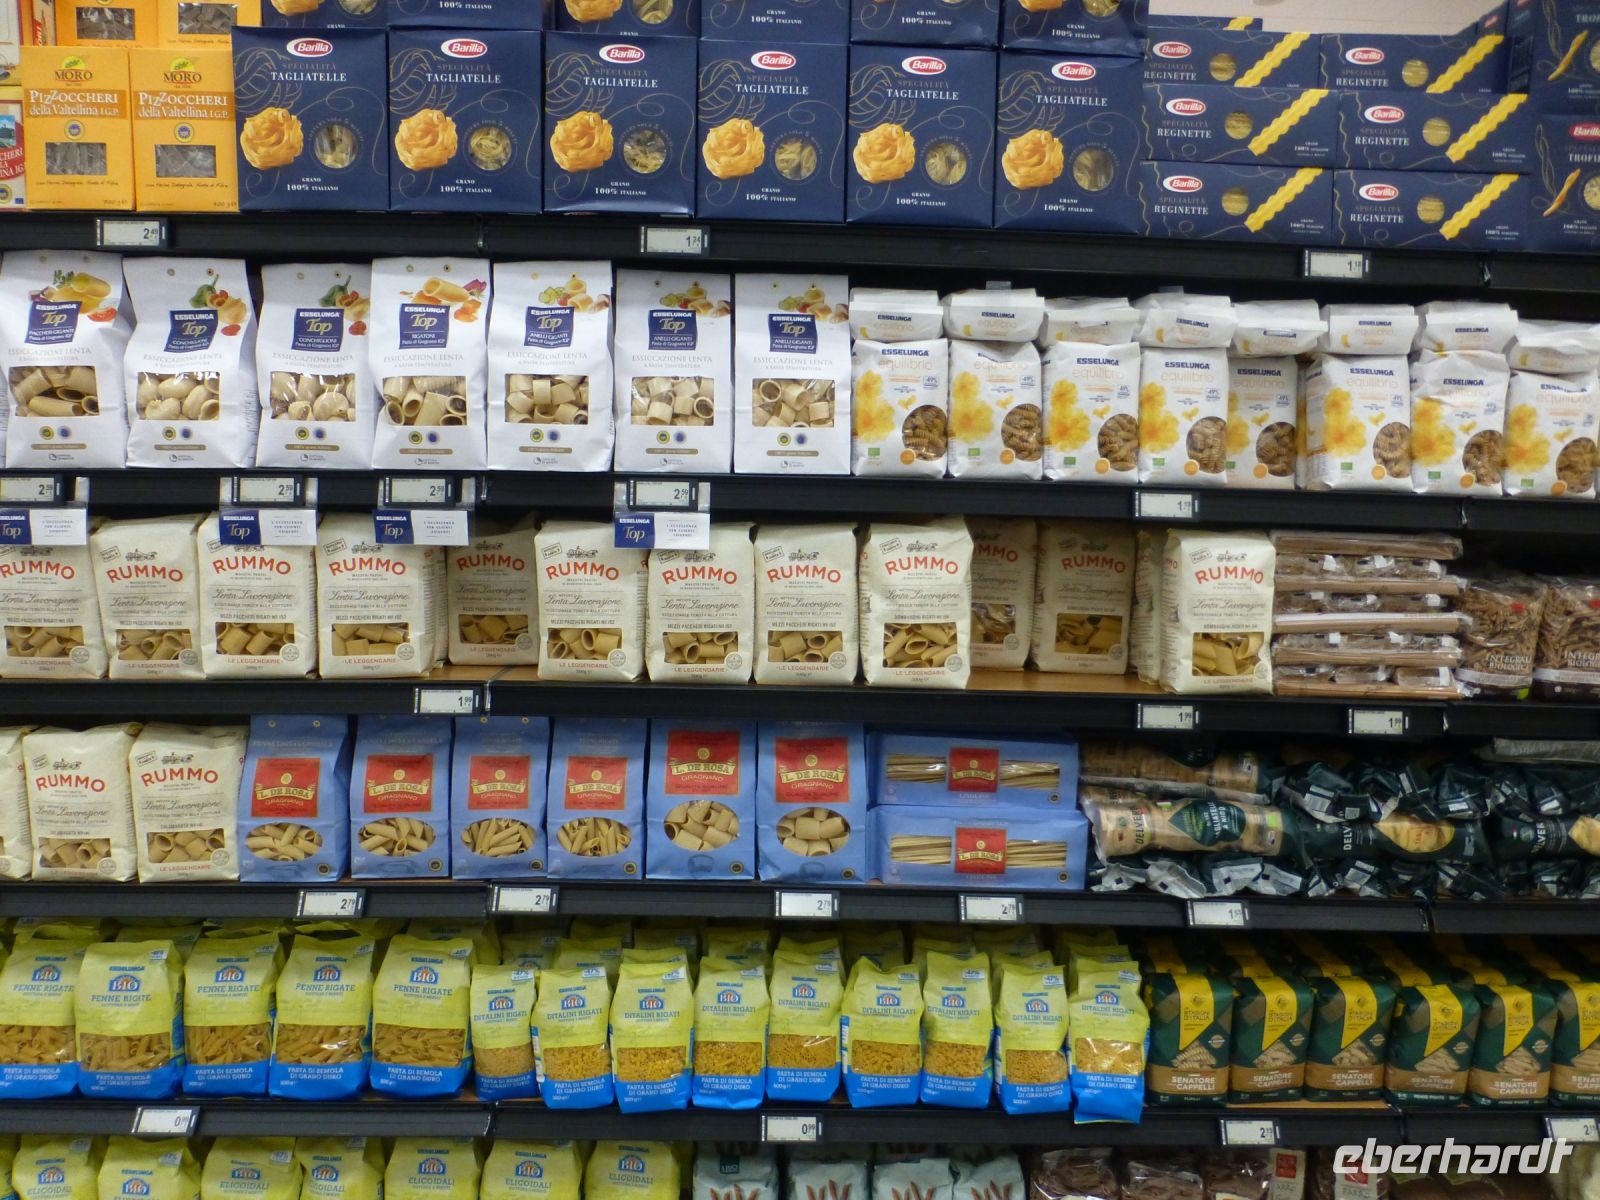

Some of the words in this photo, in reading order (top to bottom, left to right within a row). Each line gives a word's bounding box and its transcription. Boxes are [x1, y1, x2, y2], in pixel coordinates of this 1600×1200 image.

[297, 42, 328, 53] Barilla
[451, 43, 483, 54] Barilla
[1161, 46, 1188, 54] Barilla
[609, 48, 641, 60] Barilla
[761, 54, 792, 66] Barilla
[1355, 52, 1381, 60] Barilla
[911, 60, 942, 72] Barilla
[1061, 66, 1092, 77] Barilla
[55, 70, 93, 82] MORO
[164, 72, 202, 83] MORO
[270, 72, 347, 82] TAGLIATELLE
[426, 73, 501, 84] TAGLIATELLE
[583, 76, 658, 88] TAGLIATELLE
[1144, 71, 1196, 81] REGINETTE
[1336, 77, 1389, 88] REGINETTE
[736, 83, 808, 96] TAGLIATELLE
[886, 88, 959, 101] TAGLIATELLE
[1036, 94, 1108, 107] TAGLIATELLE
[30, 104, 50, 116] della
[51, 104, 98, 117] Valtellina
[138, 106, 159, 118] della
[160, 105, 208, 119] Valtellina
[1175, 102, 1203, 112] Barilla
[1374, 110, 1401, 119] Barilla
[1158, 128, 1212, 138] REGINETTE
[1355, 136, 1410, 146] REGINETTE
[1172, 180, 1200, 189] Barilla
[1368, 188, 1395, 196] Barilla
[1154, 204, 1208, 215] REGINETTE
[1350, 214, 1404, 224] REGINETTE
[42, 312, 67, 326] Top
[410, 313, 438, 330] Top
[536, 315, 562, 331] Top
[182, 322, 207, 336] Top
[306, 318, 332, 334] Top
[659, 318, 686, 334] Top
[780, 322, 805, 338] Top
[882, 348, 929, 357] ESSELUNGA
[1076, 358, 1120, 366] ESSELUNGA
[1165, 362, 1210, 370] ESSELUNGA
[1238, 368, 1282, 377] ESSELUNGA
[1350, 368, 1394, 377] ESSELUNGA
[1444, 378, 1484, 386] ESSELUNGA
[230, 524, 250, 540] Top
[383, 524, 404, 540] Top
[624, 526, 646, 542] Top
[212, 556, 291, 575] RUMMO
[328, 557, 406, 576] RUMMO
[456, 552, 525, 572] RUMMO
[884, 556, 958, 576] RUMMO
[1061, 554, 1126, 574] RUMMO
[0, 560, 75, 580] RUMMO
[106, 564, 184, 583] RUMMO
[546, 562, 620, 581] RUMMO
[662, 566, 738, 585] RUMMO
[766, 564, 842, 584] RUMMO
[1195, 566, 1264, 585] RUMMO
[686, 764, 701, 772] DE
[704, 764, 730, 775] ROSA
[140, 767, 218, 787] RUMMO
[797, 771, 812, 779] DE
[814, 772, 840, 782] ROSA
[36, 774, 106, 792] RUMMO
[383, 784, 395, 792] DE
[398, 784, 423, 794] ROSA
[217, 970, 242, 982] BIO
[316, 970, 340, 982] BIO
[413, 972, 436, 984] BIO
[198, 985, 226, 993] PENNE
[228, 984, 260, 992] RIGATE
[296, 983, 324, 991] PENNE
[394, 984, 422, 993] PENNE
[424, 988, 453, 996] RIGATE
[474, 1012, 504, 1021] DITALINI
[506, 1010, 526, 1018] RIGATI
[1172, 1076, 1216, 1084] SENATORE
[1176, 1082, 1216, 1090] CAPPELLI
[1494, 1080, 1538, 1088] SENATORE
[408, 1177, 454, 1186] ELICOIDALI
[505, 1178, 552, 1190] ELICOIDALI
